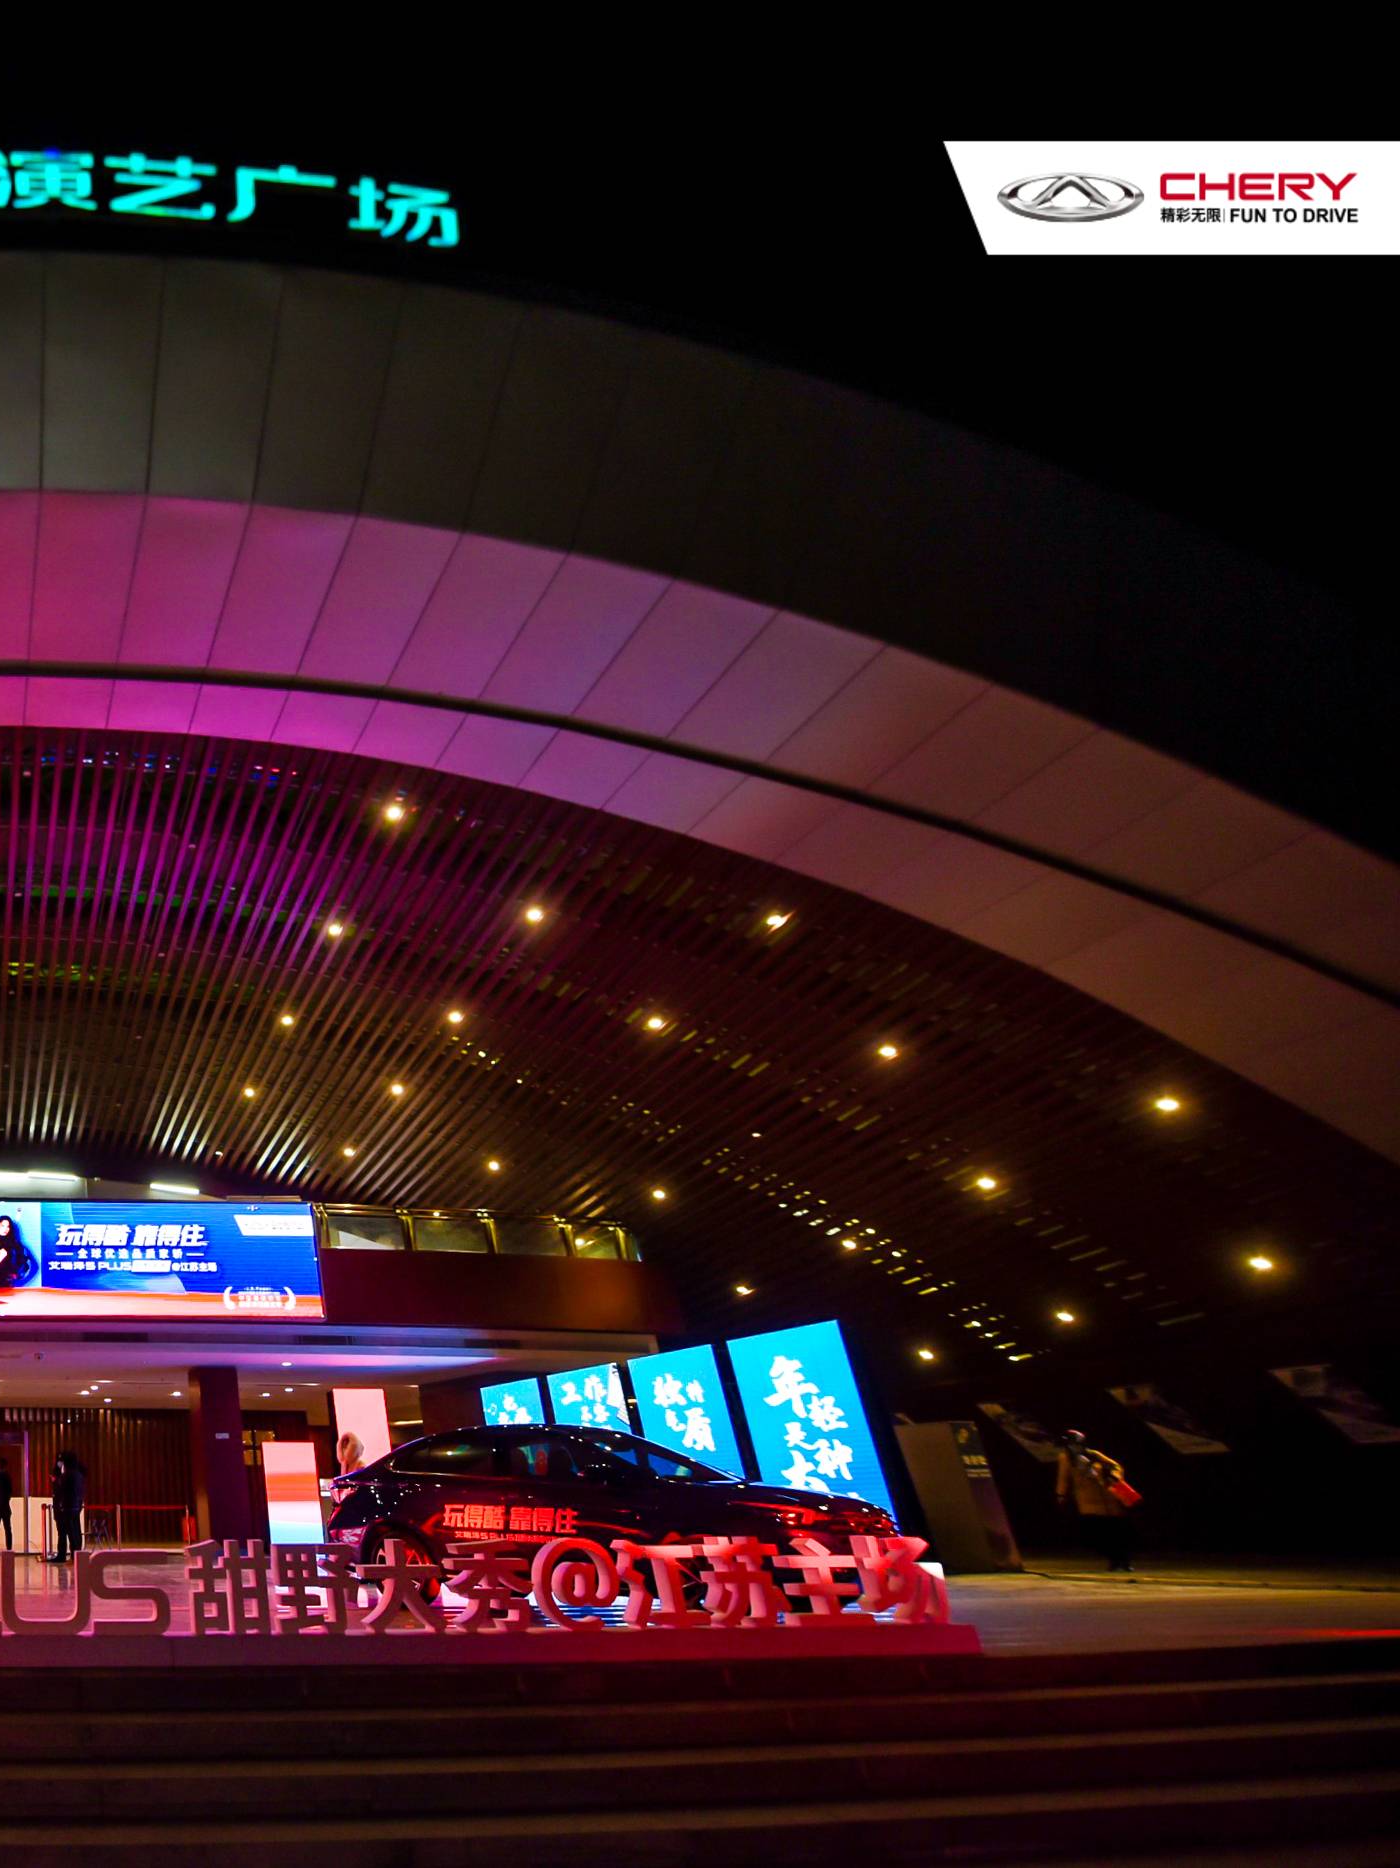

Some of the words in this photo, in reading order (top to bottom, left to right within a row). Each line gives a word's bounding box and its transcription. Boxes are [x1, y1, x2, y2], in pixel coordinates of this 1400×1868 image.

[443, 1504, 505, 1530] 玩得酷
[509, 1507, 579, 1534] 靠得住
